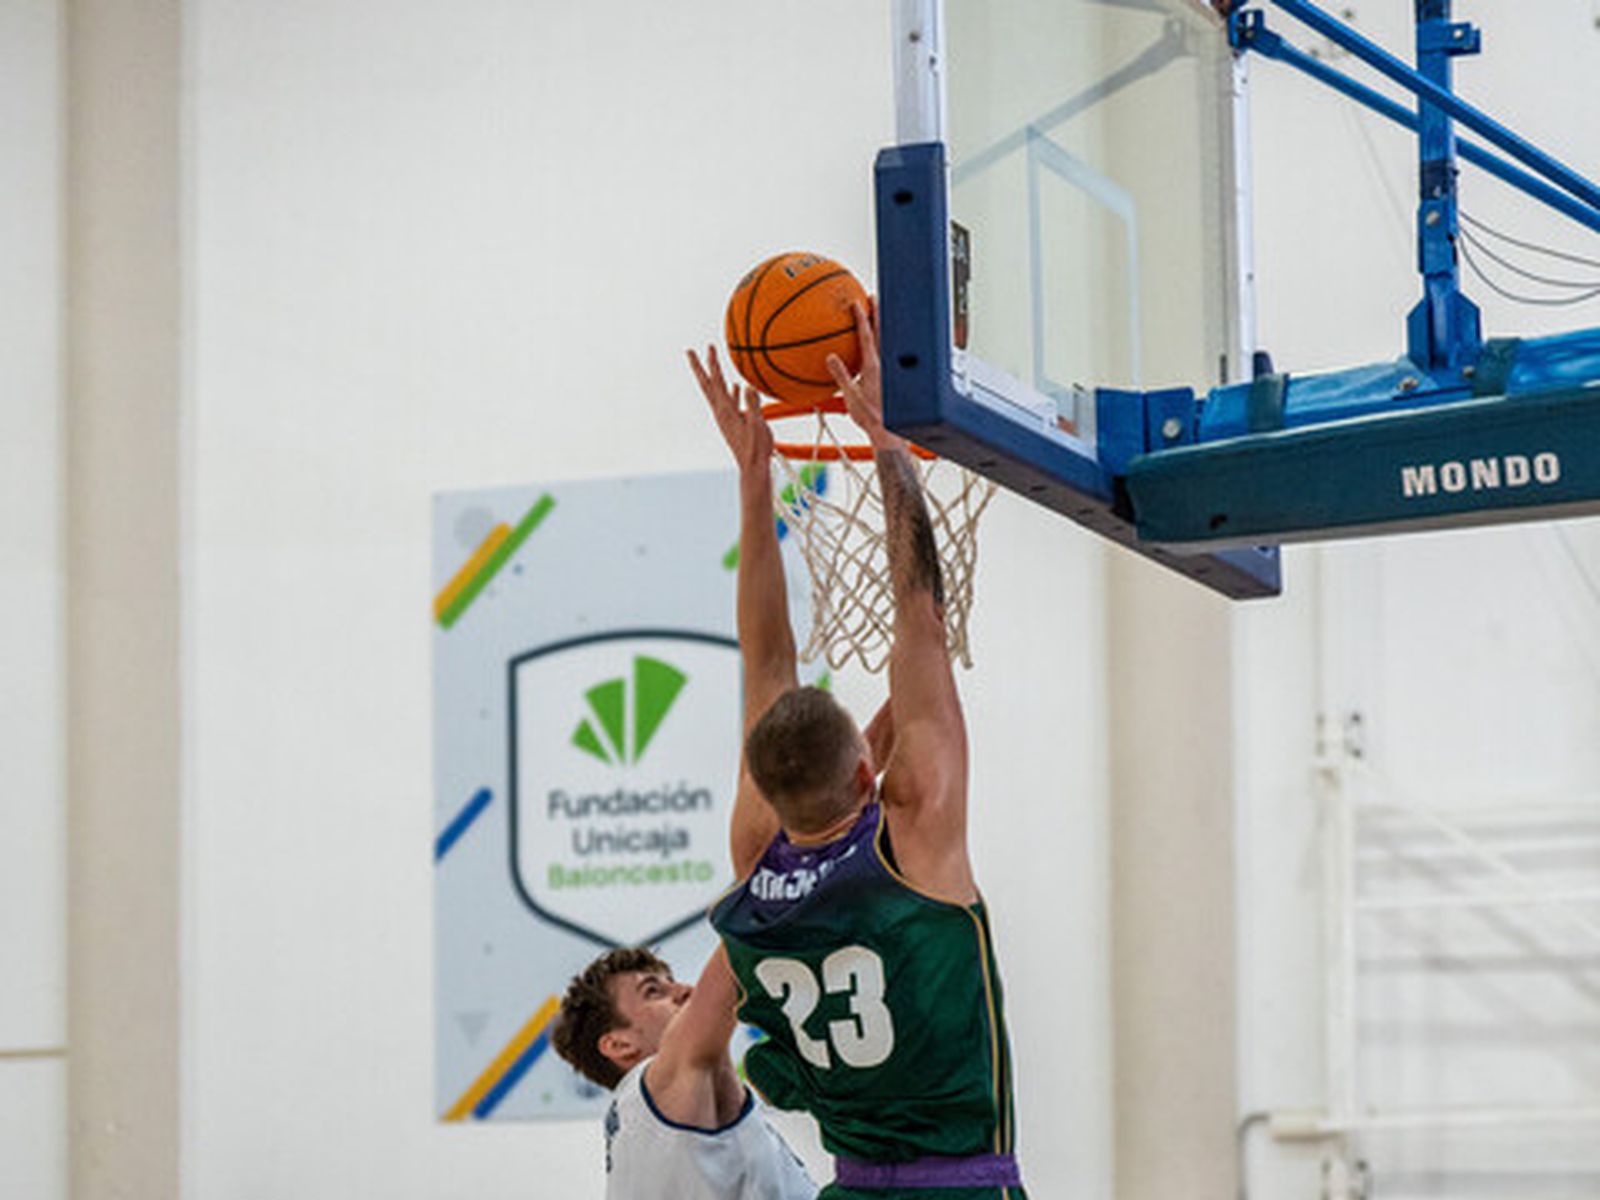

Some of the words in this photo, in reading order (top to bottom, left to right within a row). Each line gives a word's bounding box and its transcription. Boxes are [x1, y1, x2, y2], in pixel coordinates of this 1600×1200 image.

[1402, 452, 1560, 497] MONDO
[547, 780, 712, 820] Fundación
[572, 824, 689, 858] Unicaja
[548, 859, 714, 889] Baloncesto
[755, 945, 895, 1069] 23
